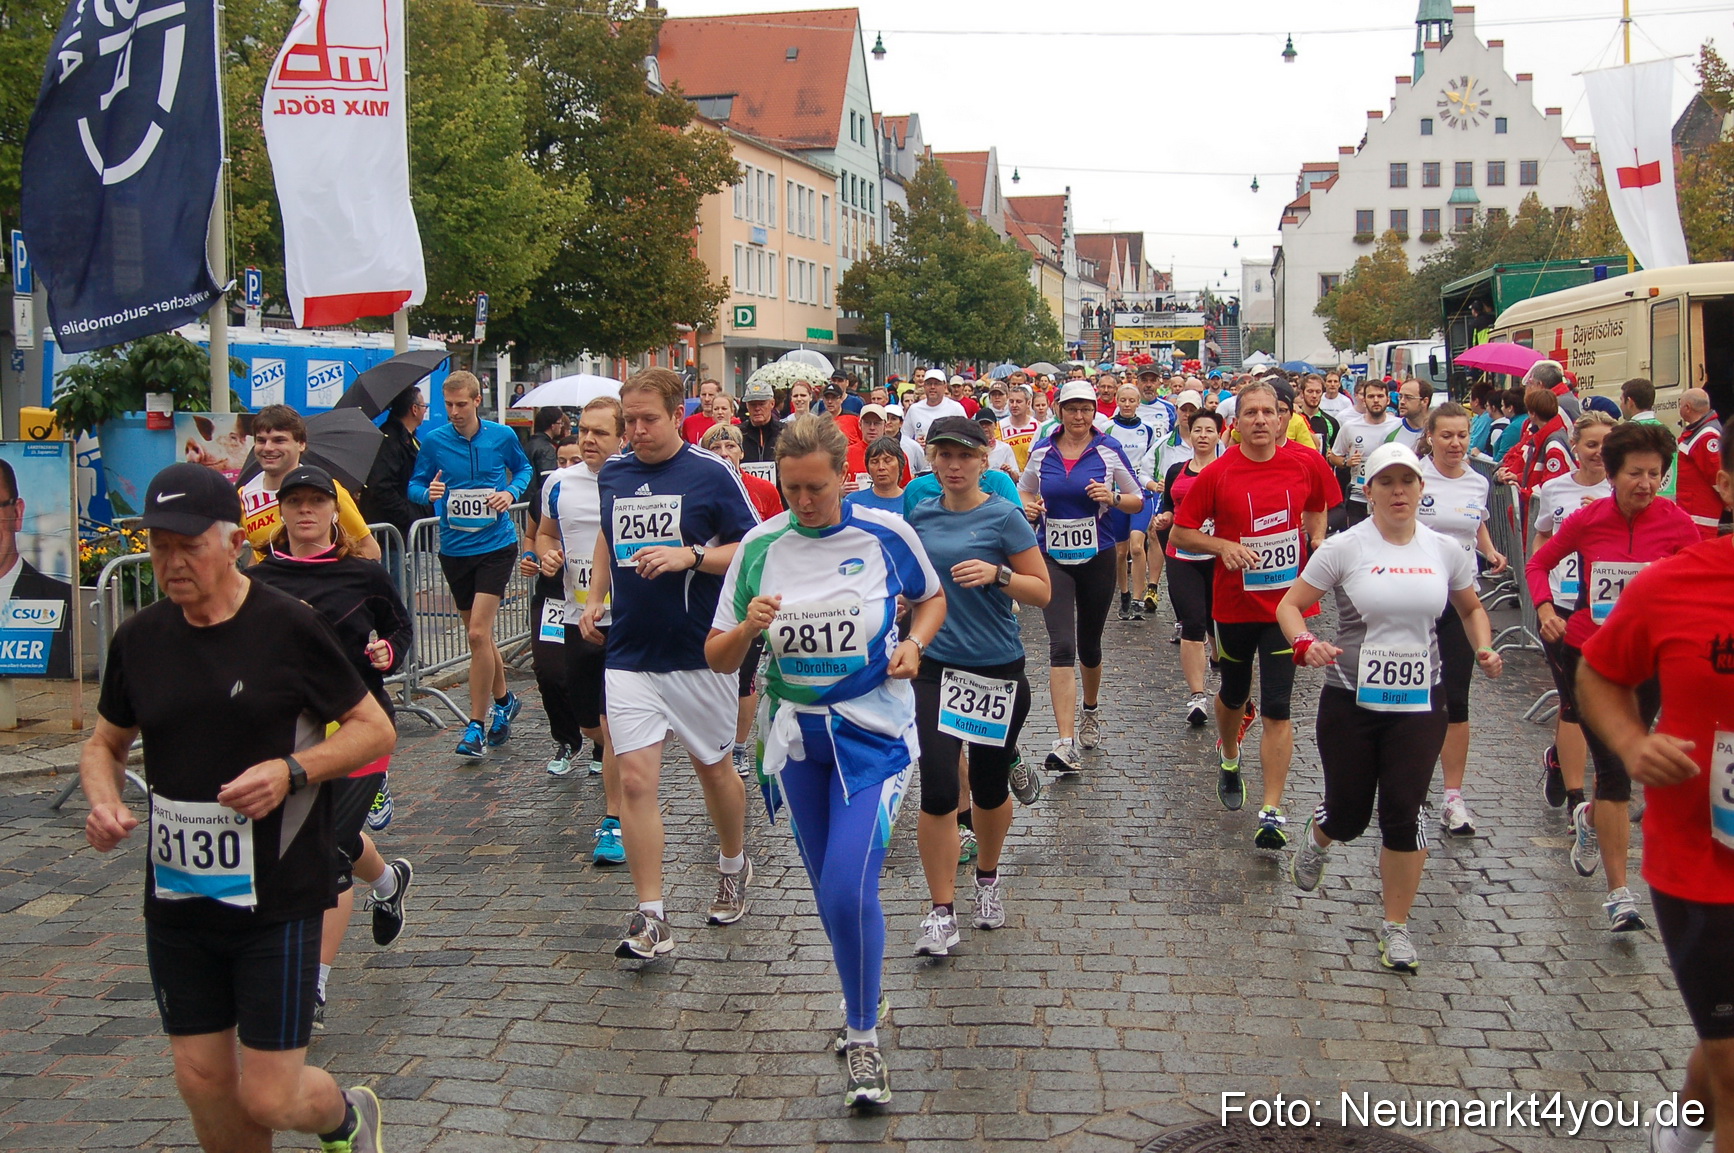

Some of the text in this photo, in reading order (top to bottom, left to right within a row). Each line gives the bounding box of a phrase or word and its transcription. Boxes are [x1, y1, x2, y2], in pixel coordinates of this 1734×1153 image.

[249, 274, 259, 301] P
[737, 308, 752, 325] D
[1143, 331, 1174, 339] START
[1573, 318, 1623, 346] Bayerisches
[1572, 348, 1595, 367] Rotes
[247, 513, 275, 534] MAX
[620, 512, 674, 539] 2542
[1051, 529, 1092, 547] 2109
[1264, 538, 1290, 547] Neumarkt
[1059, 551, 1085, 560] Dagmar
[1265, 573, 1285, 582] Peter
[12, 608, 41, 619] CSU
[802, 608, 846, 620] Neumarkt
[779, 621, 857, 653] 2812
[0, 641, 44, 659] KER
[796, 661, 847, 673] Dorothea
[1366, 660, 1425, 685] 2693
[969, 681, 1003, 692] Neumarkt
[947, 686, 1006, 720] 2345
[1382, 692, 1407, 704] Birgit
[955, 718, 988, 734] Kathrin
[154, 805, 230, 824] PARTL Neumarkt
[158, 823, 241, 869] 3130
